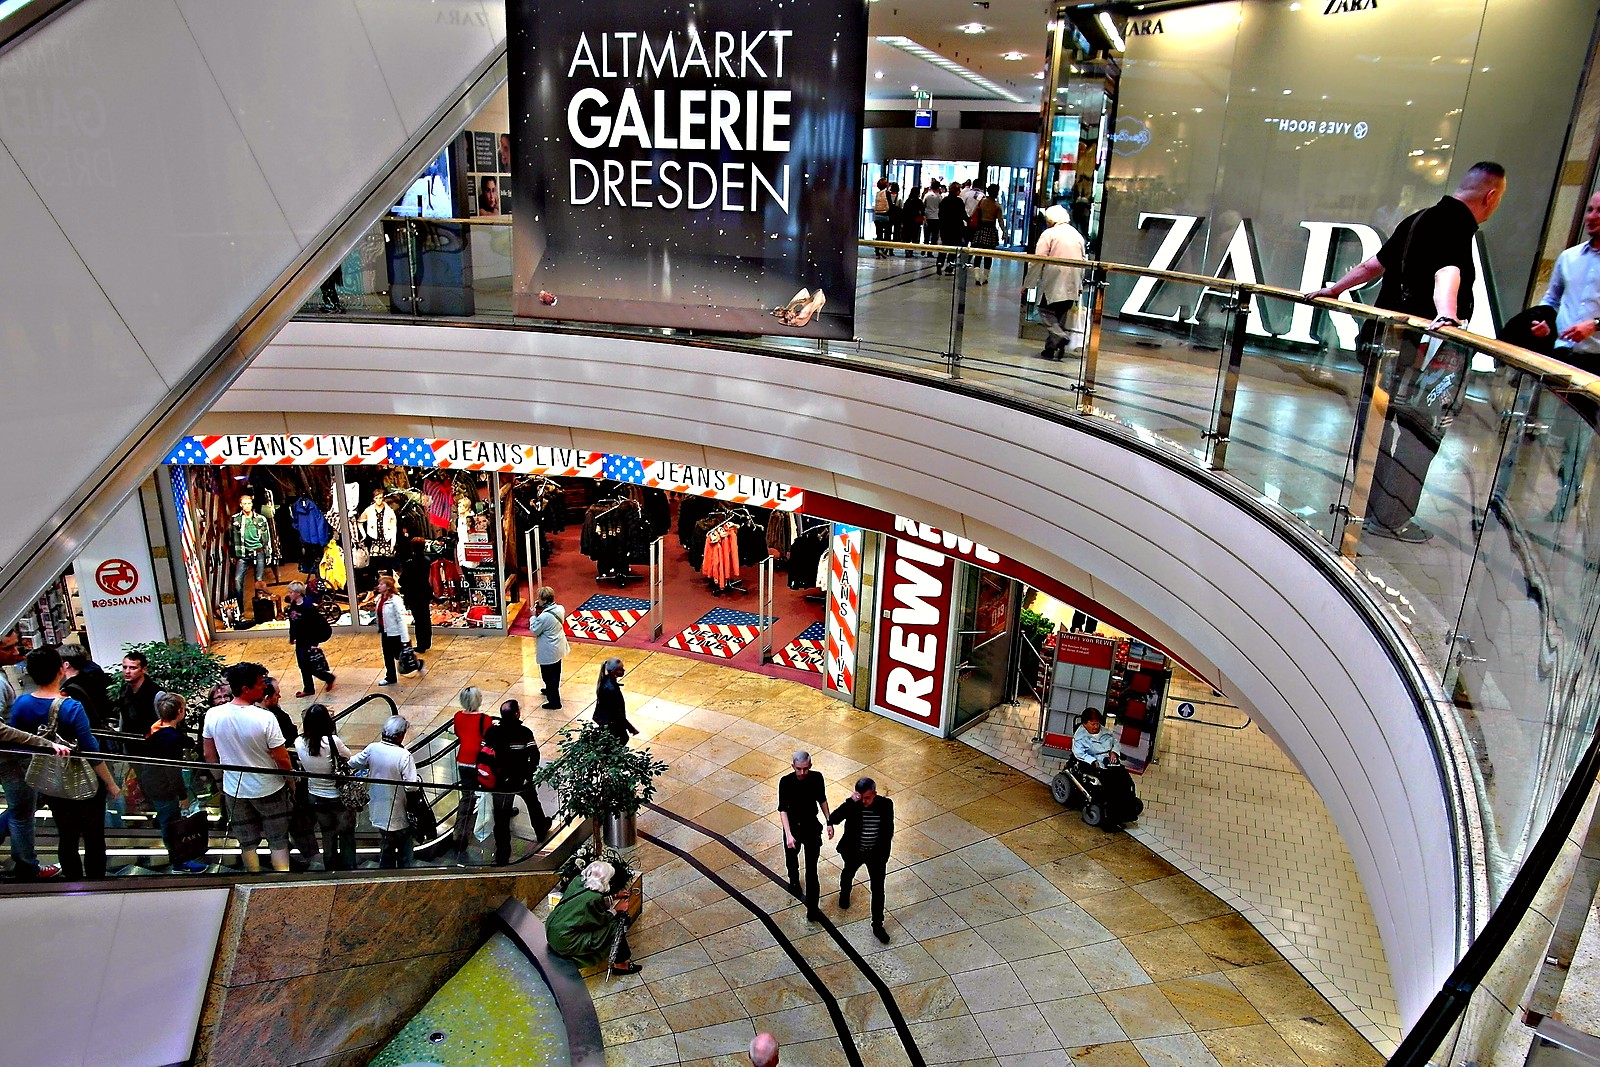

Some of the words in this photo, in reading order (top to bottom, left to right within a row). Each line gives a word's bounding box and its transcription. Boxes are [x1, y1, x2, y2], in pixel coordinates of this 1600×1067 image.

[567, 30, 793, 79] ALTMARKT
[567, 87, 792, 152] GALERIE
[569, 158, 790, 215] DRESDEN
[222, 435, 303, 457] JEANS
[317, 435, 372, 456] LIVE
[449, 438, 522, 465] JEANS
[536, 445, 587, 469] LIVE
[656, 461, 726, 491] JEANS
[737, 470, 787, 502] LIVE
[839, 539, 851, 617] JEANS
[91, 595, 152, 608] ROSSMANN
[569, 623, 610, 635] LIVE
[571, 615, 627, 628] JEANS
[685, 637, 729, 651] LIVE
[687, 629, 746, 644] JEANS
[1095, 639, 1113, 648] REWE
[790, 654, 824, 667] LIV
[836, 628, 846, 689] LIVE
